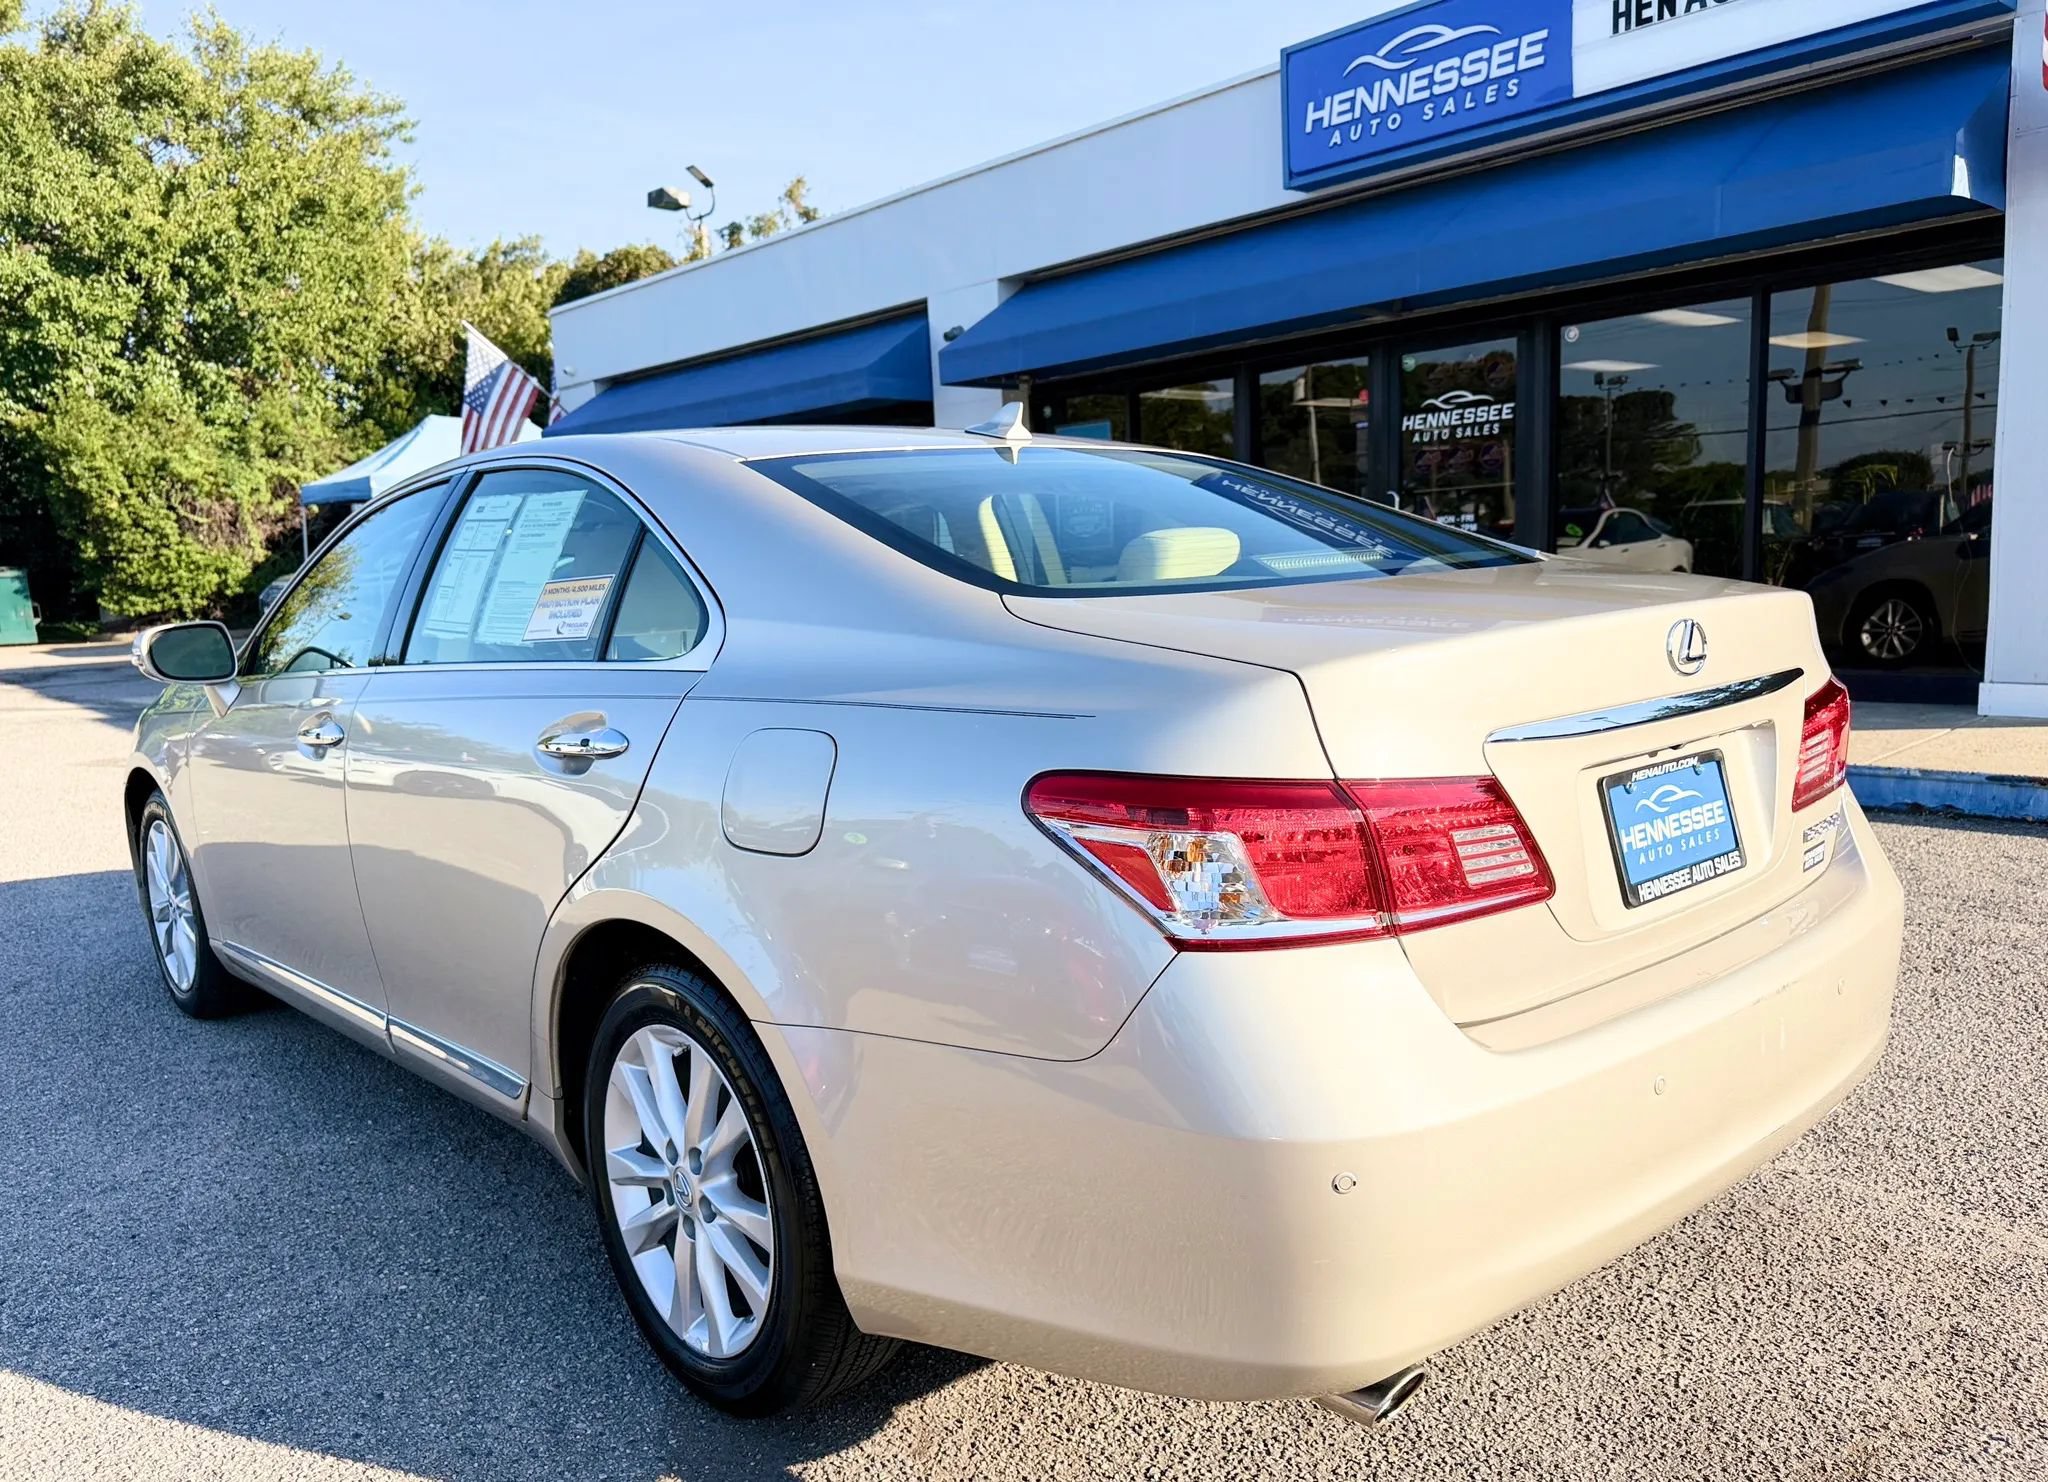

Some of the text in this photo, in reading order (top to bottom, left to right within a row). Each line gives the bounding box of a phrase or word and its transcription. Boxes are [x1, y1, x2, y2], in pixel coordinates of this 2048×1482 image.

[1304, 28, 1549, 134] HENNESSEE
[1328, 78, 1520, 148] AUTO SALES
[1402, 402, 1516, 431] HENNESSEE
[1412, 422, 1500, 443] AUTO SALES
[1631, 755, 1699, 782] HENAUTO.COM
[1620, 799, 1726, 853] HENNESSEE
[1639, 827, 1721, 865] AUTO SALES
[1637, 850, 1742, 903] HENNESSEE AUTO SALES
